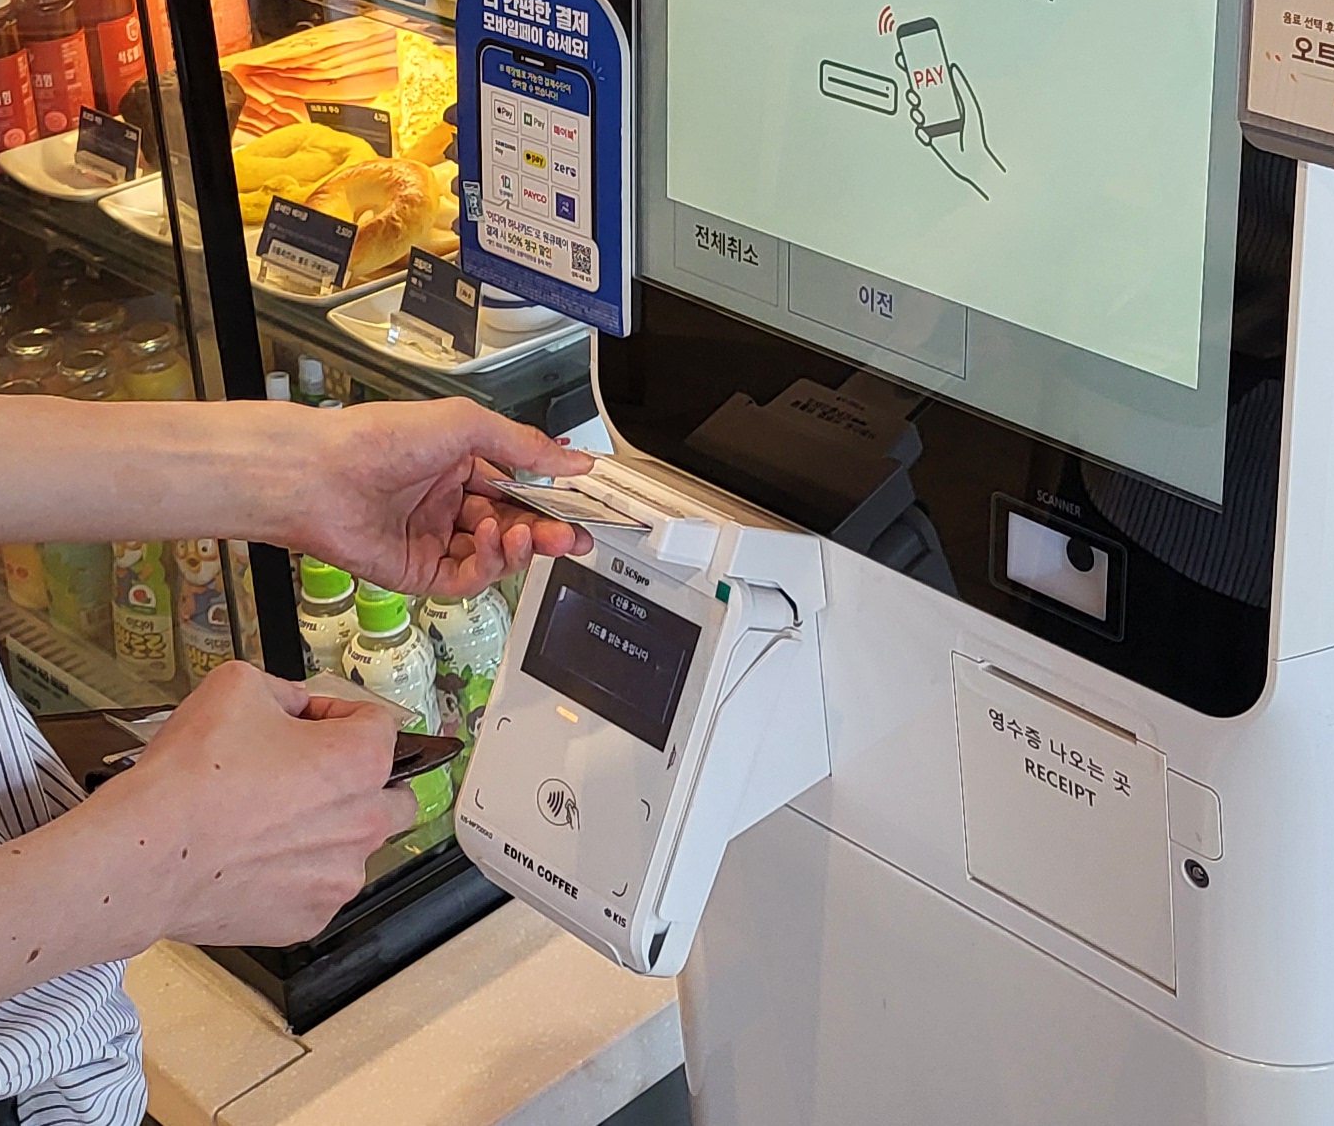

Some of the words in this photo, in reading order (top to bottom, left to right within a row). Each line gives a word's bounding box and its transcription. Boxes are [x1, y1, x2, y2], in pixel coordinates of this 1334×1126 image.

[556, 5, 589, 36] 결제
[1283, 12, 1302, 25] 음료
[1304, 16, 1323, 32] 선택
[483, 12, 543, 46] 모바일페이
[547, 29, 588, 59] 하세요!
[913, 64, 944, 89] PAY
[502, 107, 513, 120] Pay
[534, 116, 545, 130] Pay
[531, 155, 543, 165] pay
[524, 189, 547, 204] PAYCO
[486, 224, 498, 239] 결제
[500, 230, 506, 241] 시
[508, 232, 523, 247] 50%
[694, 224, 759, 267] 전체취소
[858, 284, 894, 320] 이전
[1036, 489, 1082, 517] SCANNER
[624, 567, 650, 586] SCSpro
[427, 608, 448, 620] COFFEE
[587, 621, 607, 640] 카드를
[351, 652, 372, 664] COFFEE
[988, 708, 1041, 750] 영수증
[1050, 739, 1105, 782] 나오는
[1112, 770, 1131, 798] 곳
[1024, 757, 1096, 807] RECEIPT
[504, 843, 534, 872] EDIYA
[537, 865, 578, 900] COFFEE
[613, 912, 626, 928] KIS
